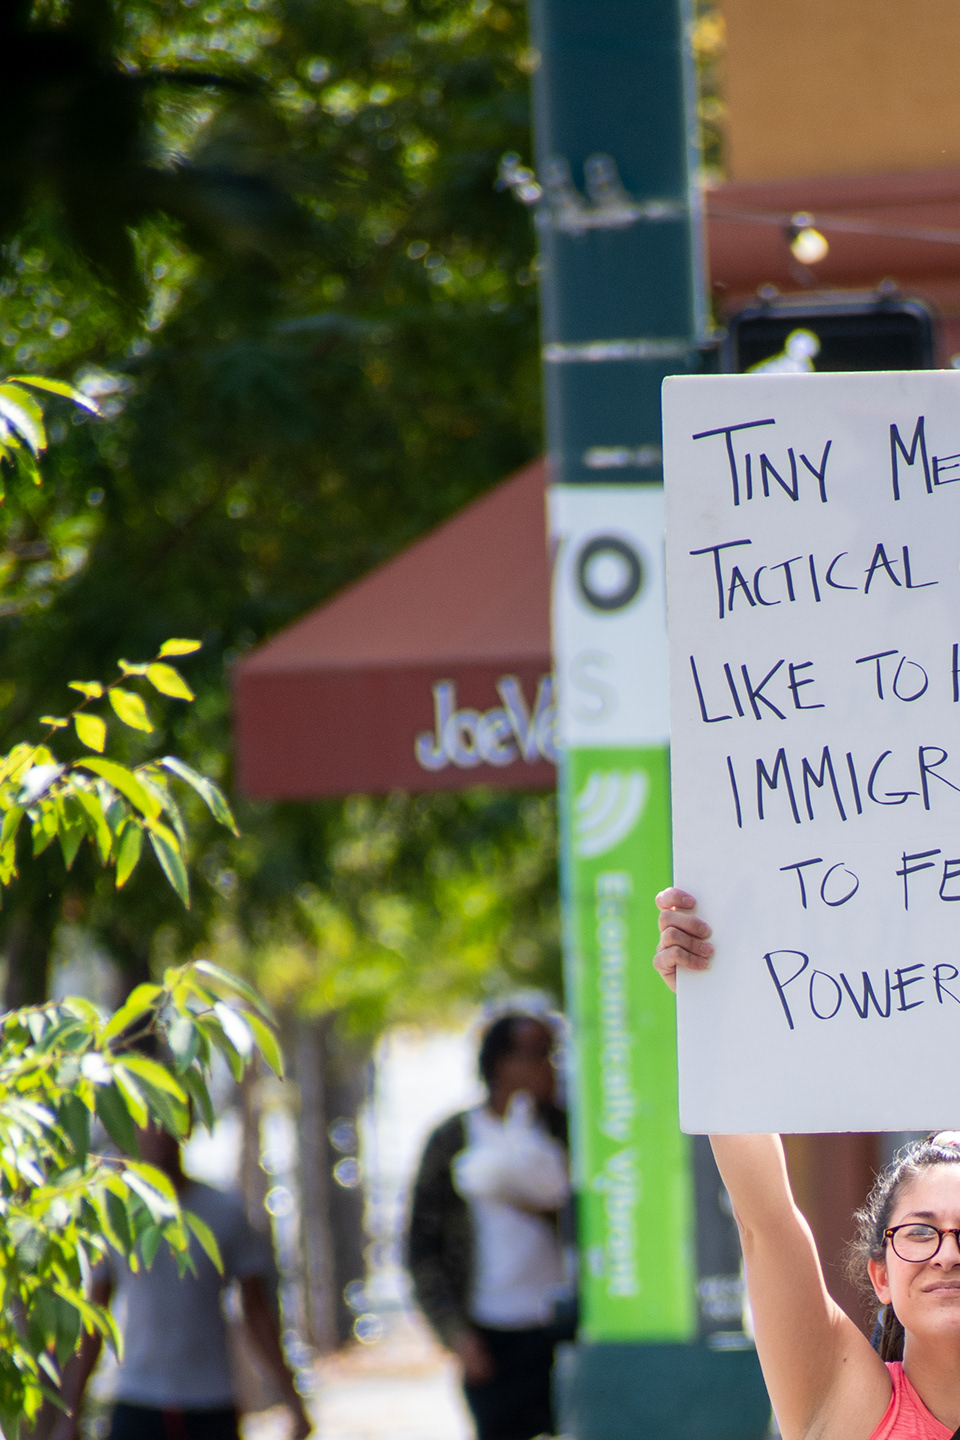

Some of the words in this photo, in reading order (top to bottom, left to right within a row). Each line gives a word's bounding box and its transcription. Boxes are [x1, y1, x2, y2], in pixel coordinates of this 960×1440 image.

[692, 418, 832, 506] TINY
[689, 538, 939, 619] TACTICAL
[690, 655, 826, 723] LIKE
[855, 649, 929, 702] TO
[779, 857, 860, 909] TO
